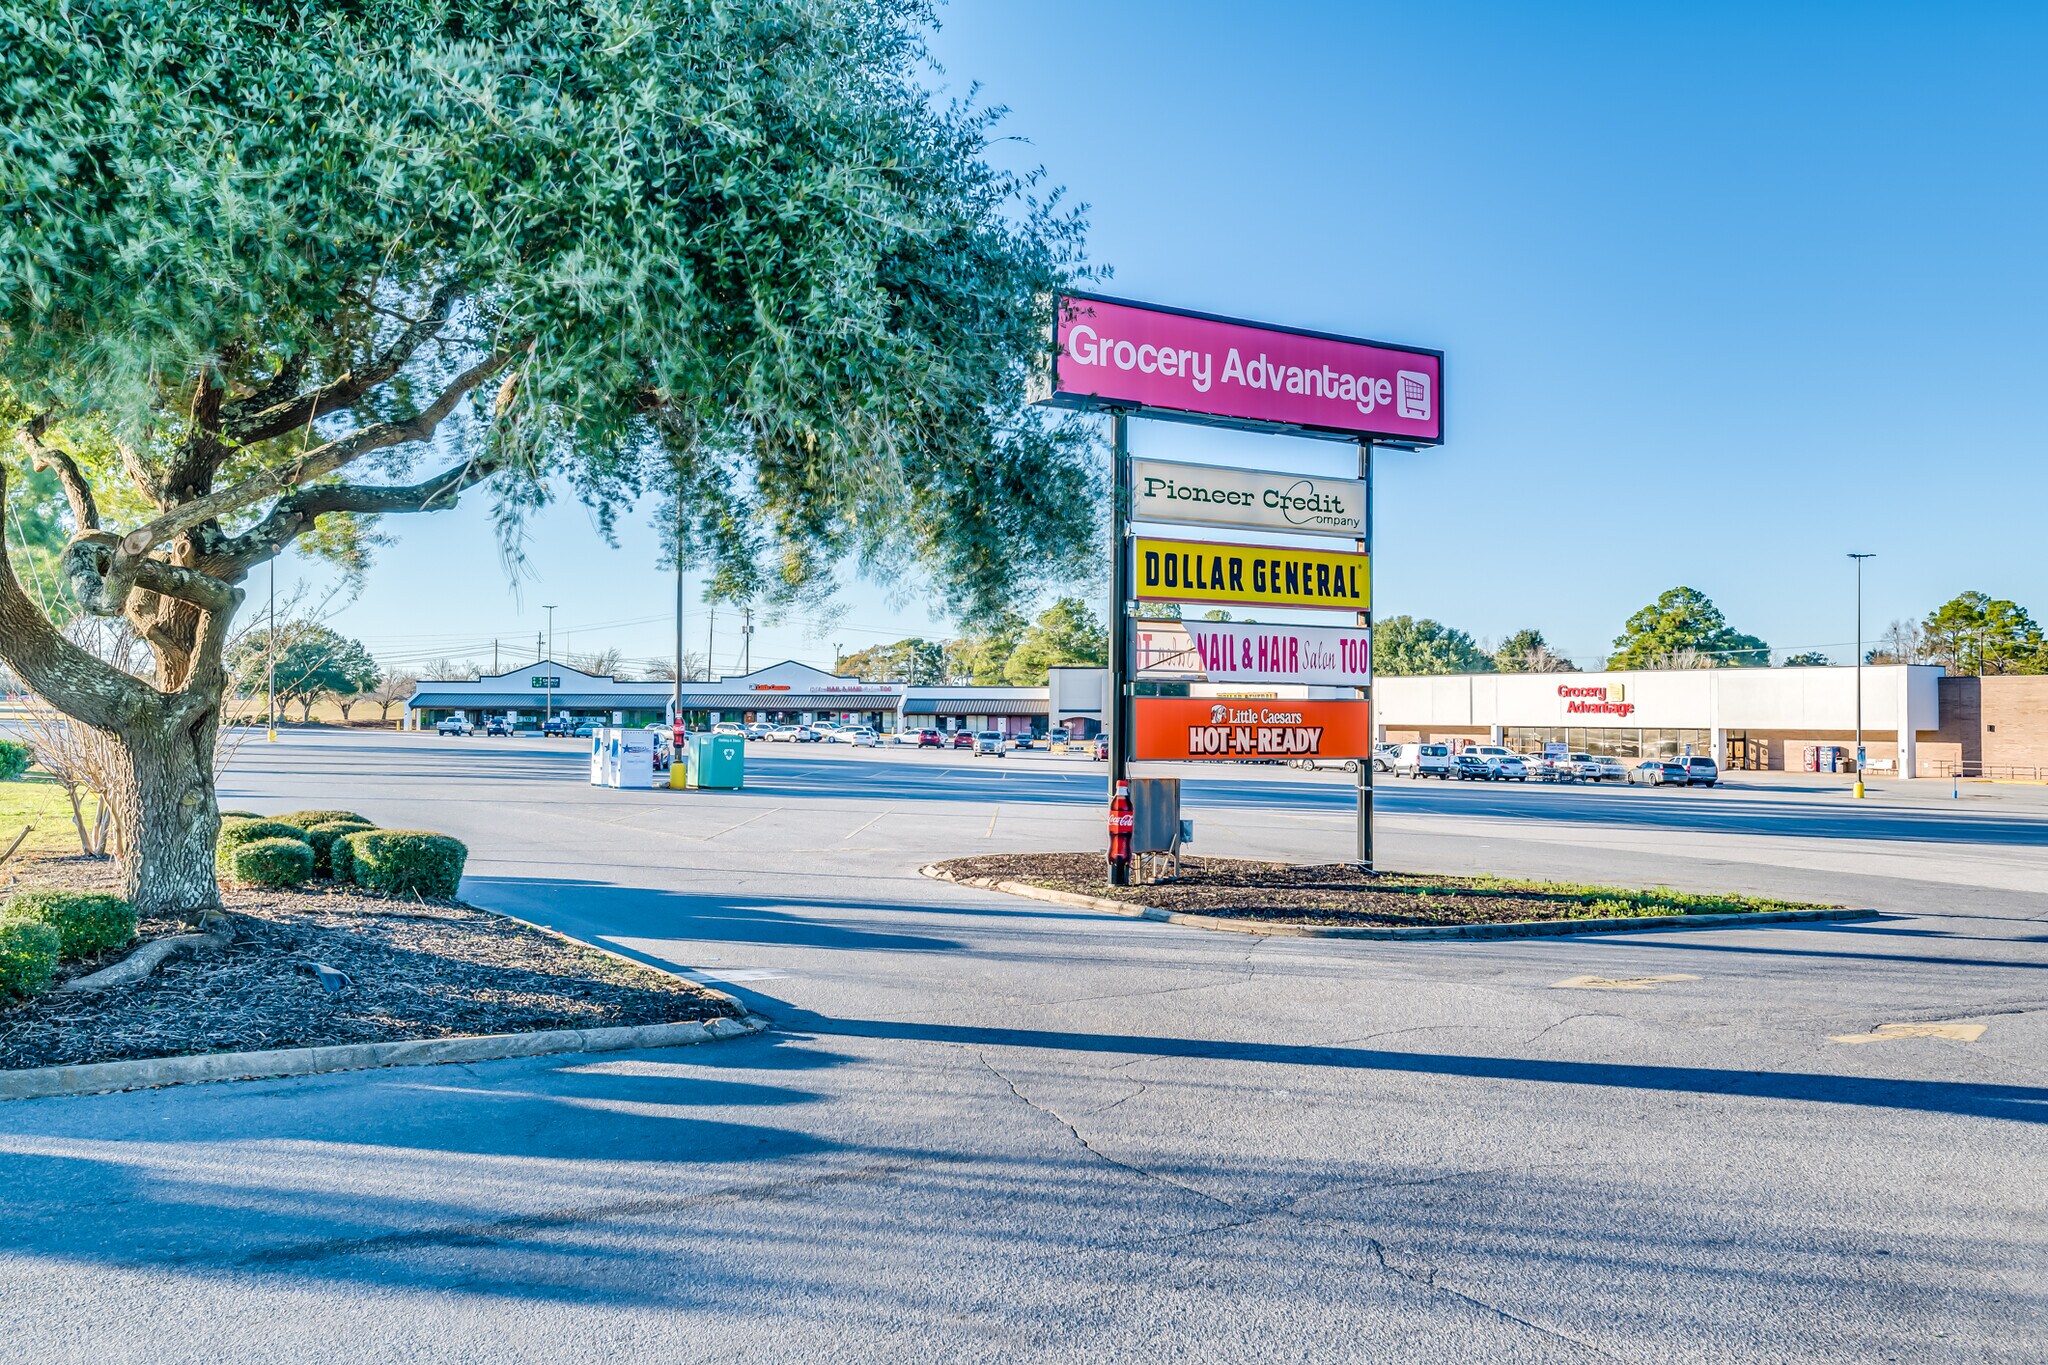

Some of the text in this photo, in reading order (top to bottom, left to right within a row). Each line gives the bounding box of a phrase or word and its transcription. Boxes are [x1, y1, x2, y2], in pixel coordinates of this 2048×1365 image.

[1068, 324, 1393, 415] Grocery Advantage
[1143, 477, 1345, 514] Pioneer Credit
[1144, 551, 1361, 599] DOLLAR GENERAL
[1197, 632, 1368, 674] NAIL & HAIR Salon TOO
[1557, 684, 1607, 701] Grocery
[1567, 701, 1635, 717] Advantage
[1228, 708, 1302, 724] Little Caesars
[1188, 726, 1323, 755] HOT-N-READY
